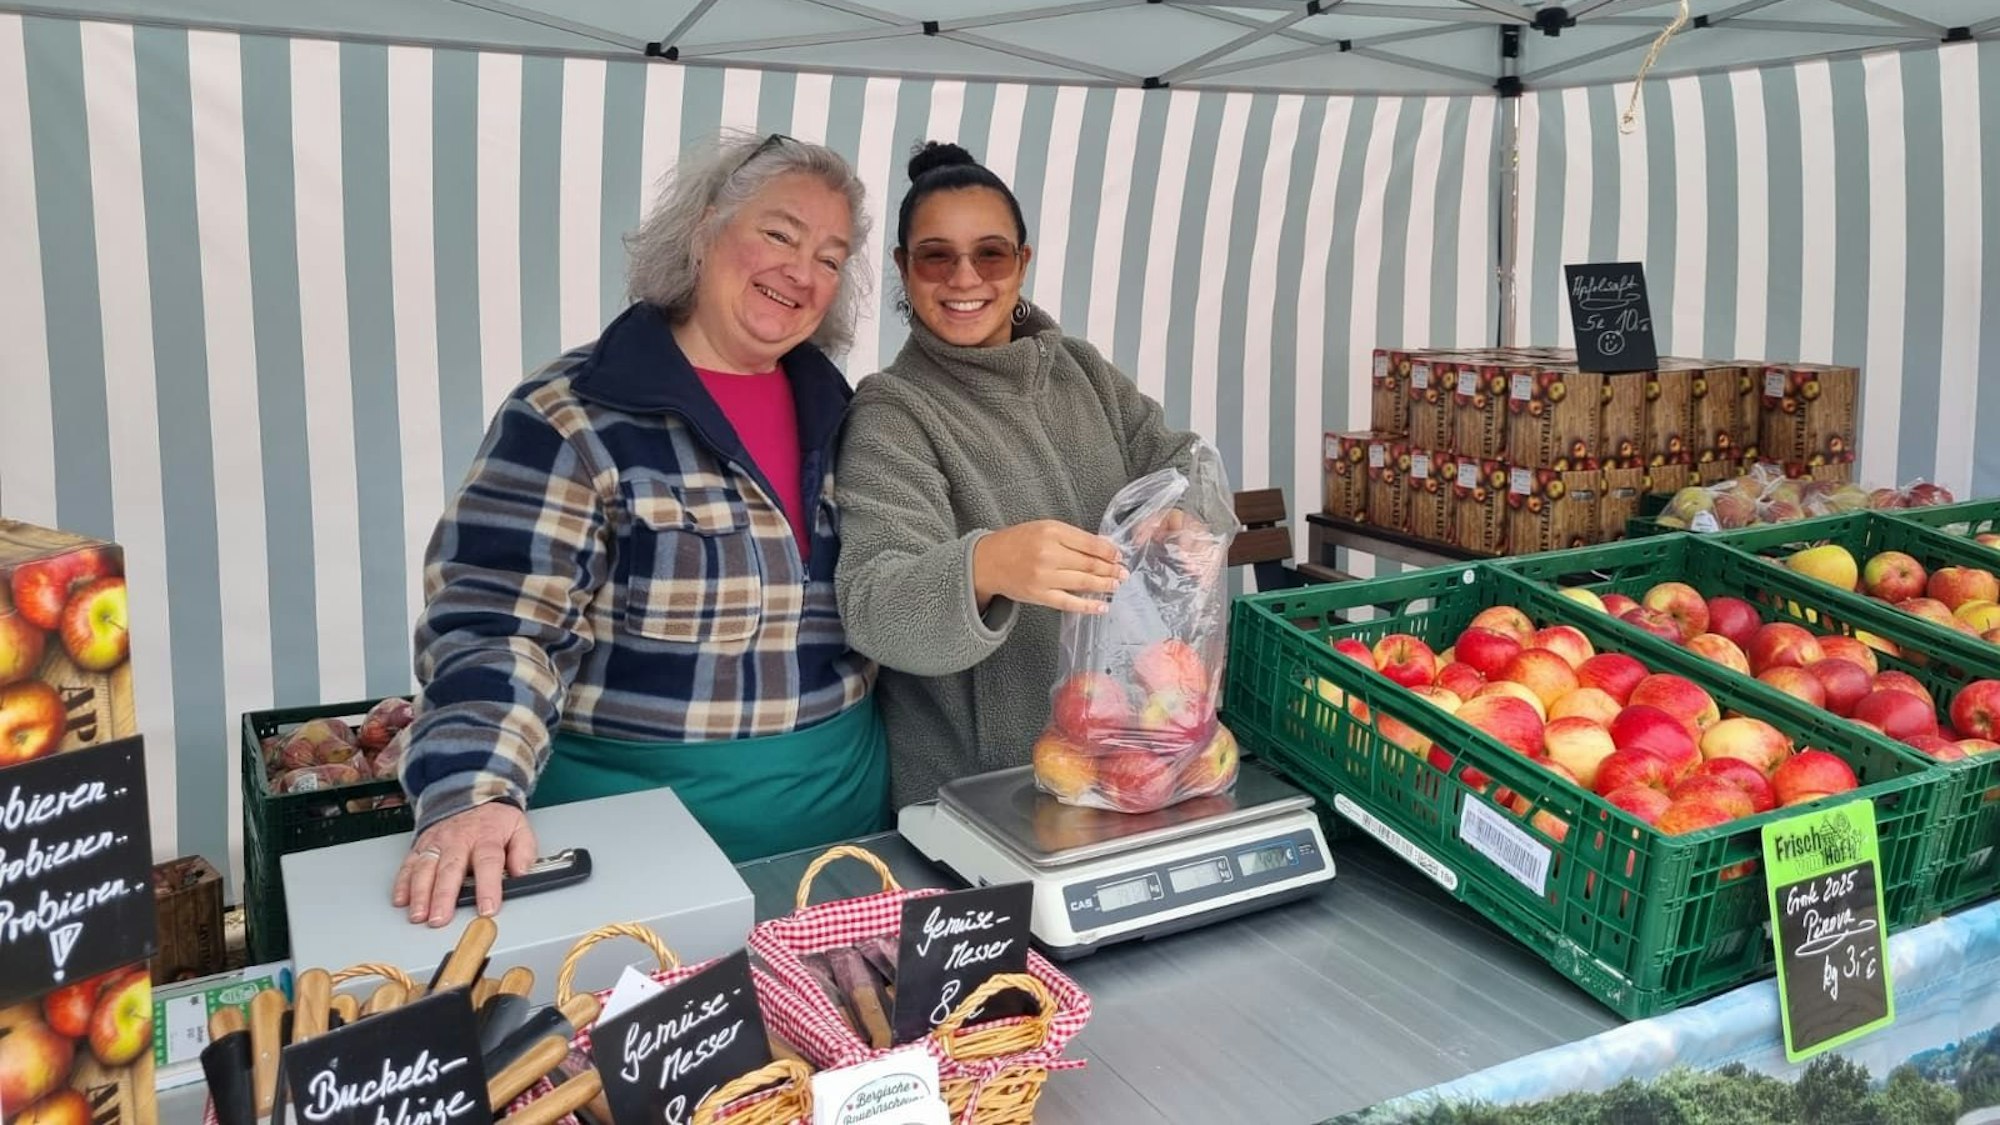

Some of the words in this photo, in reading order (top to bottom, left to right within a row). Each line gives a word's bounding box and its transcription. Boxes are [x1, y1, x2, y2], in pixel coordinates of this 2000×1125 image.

[1572, 275, 1639, 301] Apfelsaft
[1775, 826, 1821, 862] Frisch
[1822, 869, 1859, 903] 2025
[1070, 897, 1094, 912] CAS
[916, 905, 1011, 958] Gemüse-
[1803, 907, 1856, 944] Pinova
[943, 937, 1014, 971] Messer
[620, 988, 742, 1083] Gemüse-
[659, 1019, 744, 1090] Messer
[303, 1049, 469, 1122] Buckels-
[855, 1081, 911, 1110] Bergische
